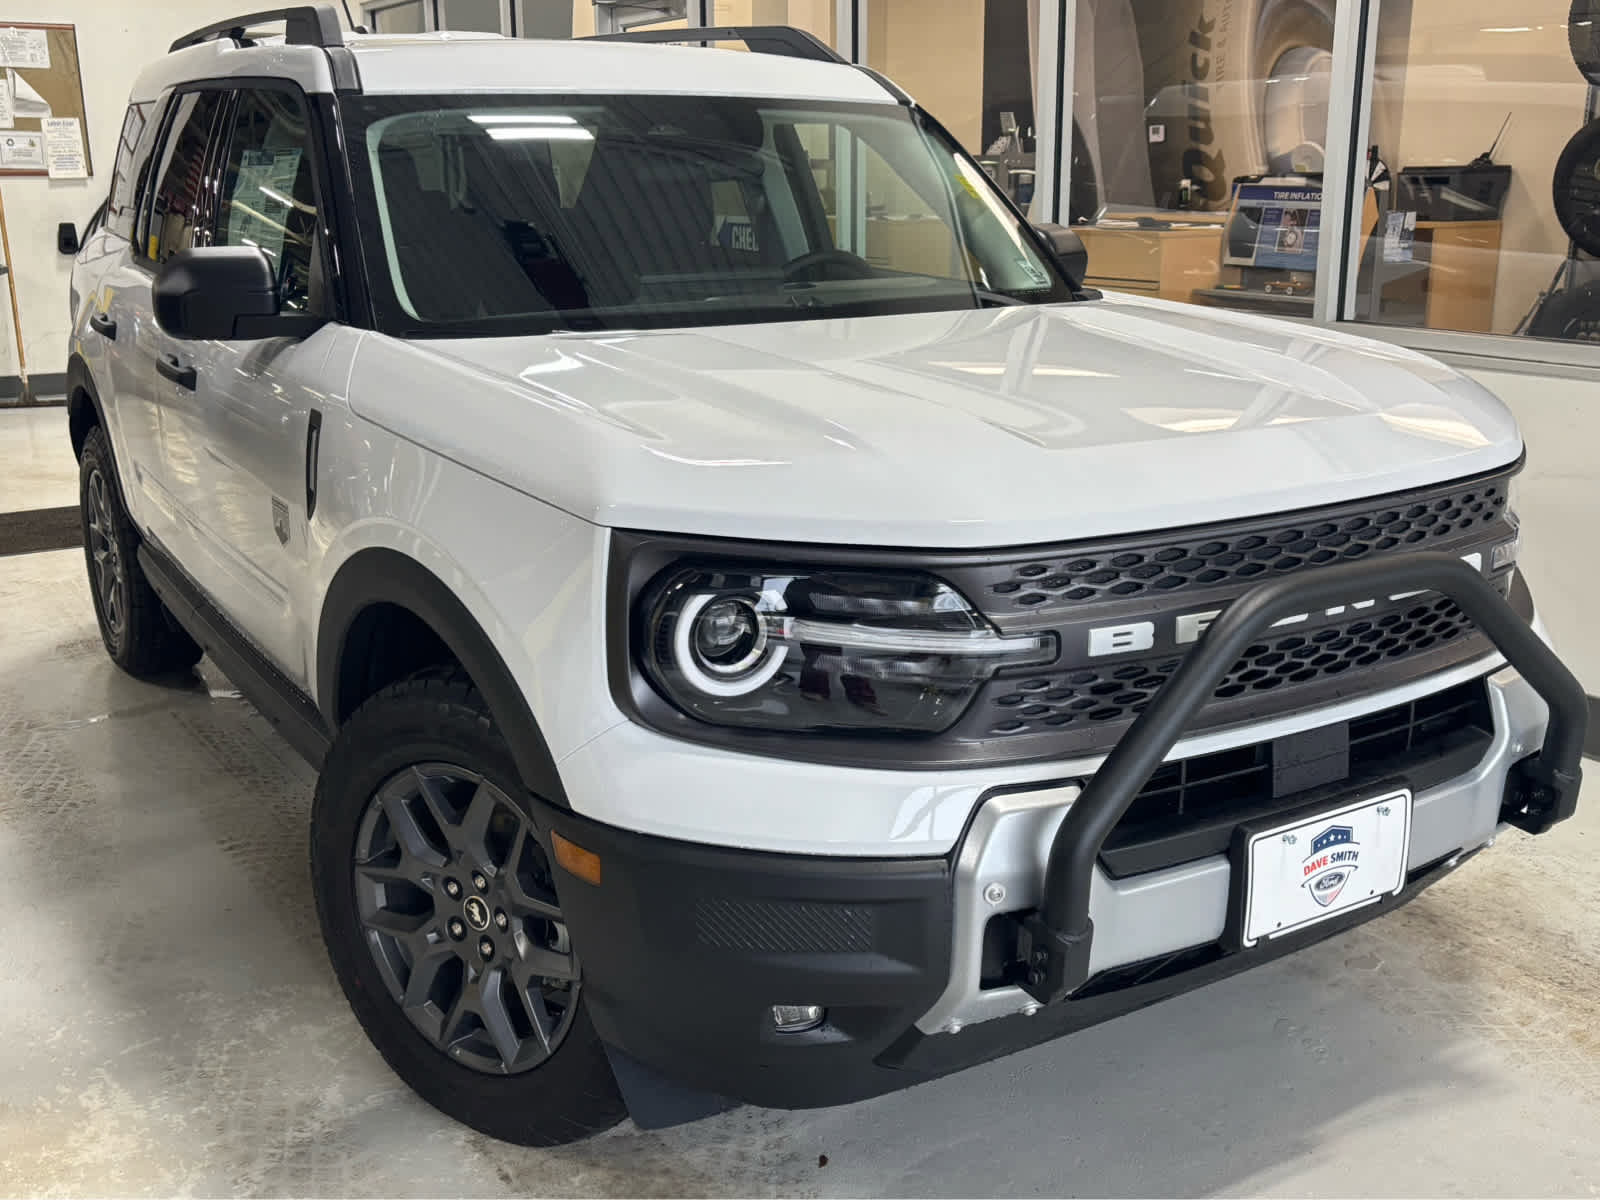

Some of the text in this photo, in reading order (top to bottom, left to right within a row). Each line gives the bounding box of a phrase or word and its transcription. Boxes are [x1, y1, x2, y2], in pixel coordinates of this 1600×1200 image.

[1273, 191, 1323, 201] TIRE INFLATIO
[1304, 851, 1359, 876] DAVE SMITH
